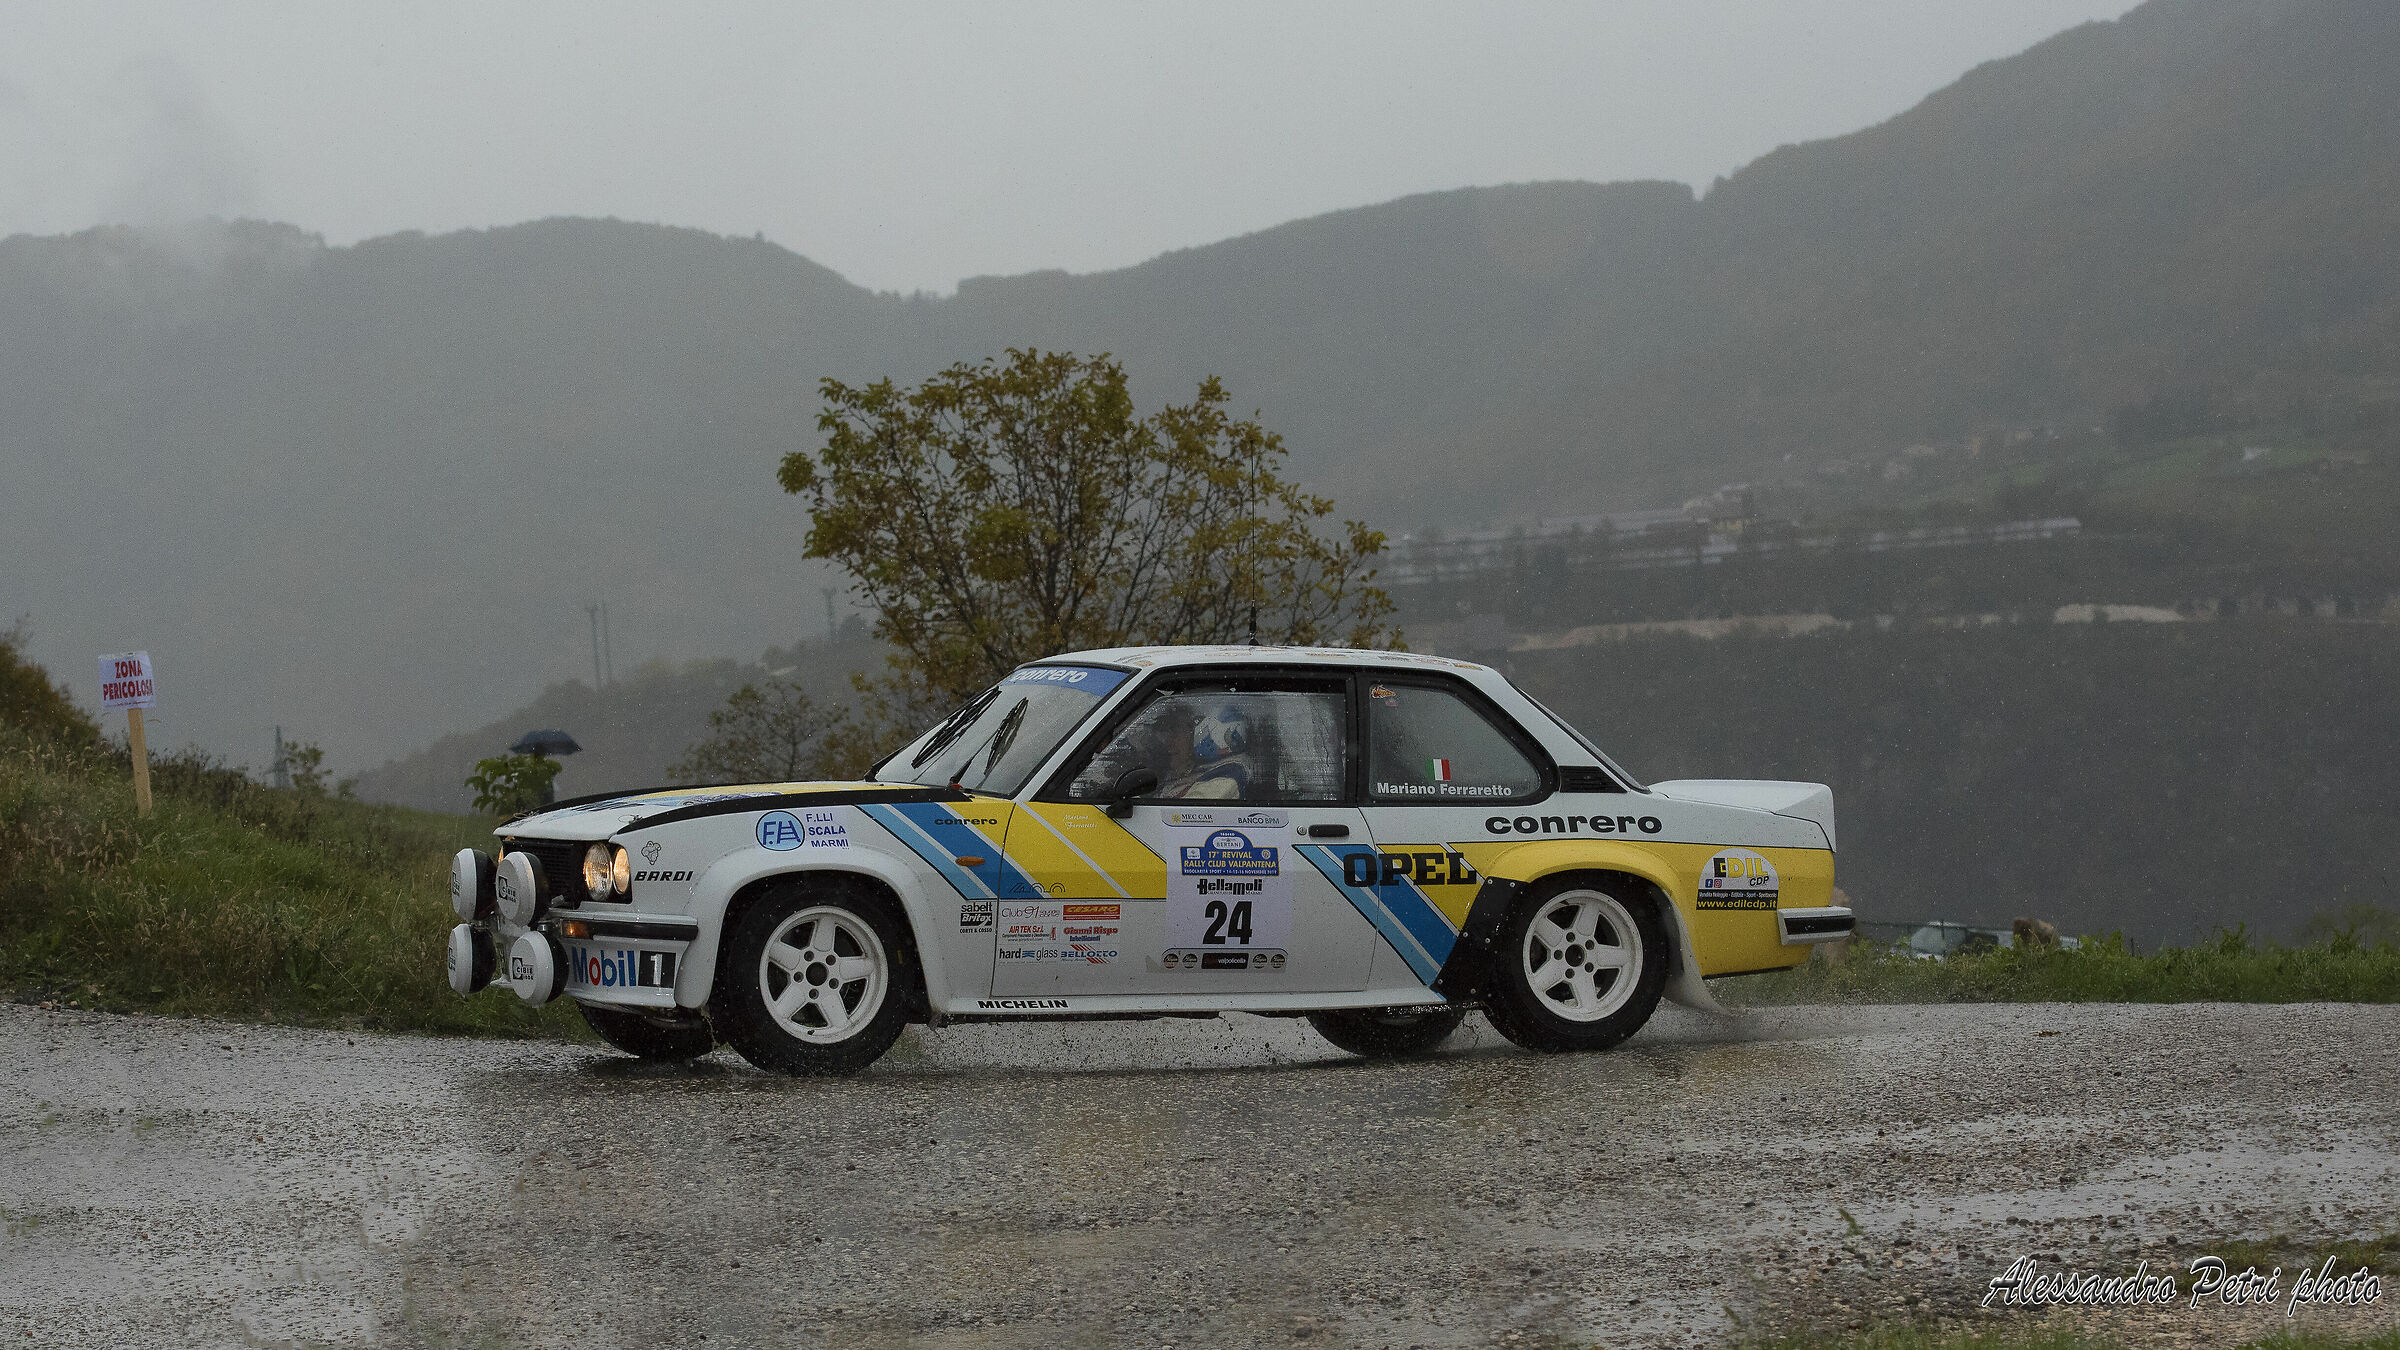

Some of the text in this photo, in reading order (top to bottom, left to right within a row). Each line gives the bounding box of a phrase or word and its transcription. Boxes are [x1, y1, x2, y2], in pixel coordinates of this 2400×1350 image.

[114, 660, 143, 679] ZONA
[103, 679, 154, 701] PERICOLOSA
[1376, 782, 1512, 797] Mariano Ferraretto
[805, 812, 834, 823] F.LLI
[934, 817, 998, 826] conrero
[1485, 815, 1663, 834] conrero
[808, 825, 847, 836] SCALA
[810, 838, 849, 848] MARMI
[1222, 851, 1252, 859] REVIVAL
[1183, 860, 1277, 869] RALLY CLUB VALPANTENA
[1343, 852, 1477, 887] OPEL
[1713, 857, 1769, 878] EDIL
[634, 871, 694, 882] BARDI
[1749, 876, 1770, 887] CDP
[961, 902, 993, 913] sabelt
[1697, 899, 1777, 910] www.edilcdp.it
[1001, 907, 1023, 918] Club
[1202, 900, 1253, 945] 24
[1063, 926, 1092, 935] Gianni
[999, 947, 1059, 961] hard glass
[1061, 950, 1118, 958] BELLOTTO
[571, 946, 663, 987] Mobil 1
[978, 999, 1069, 1009] MICHELIN
